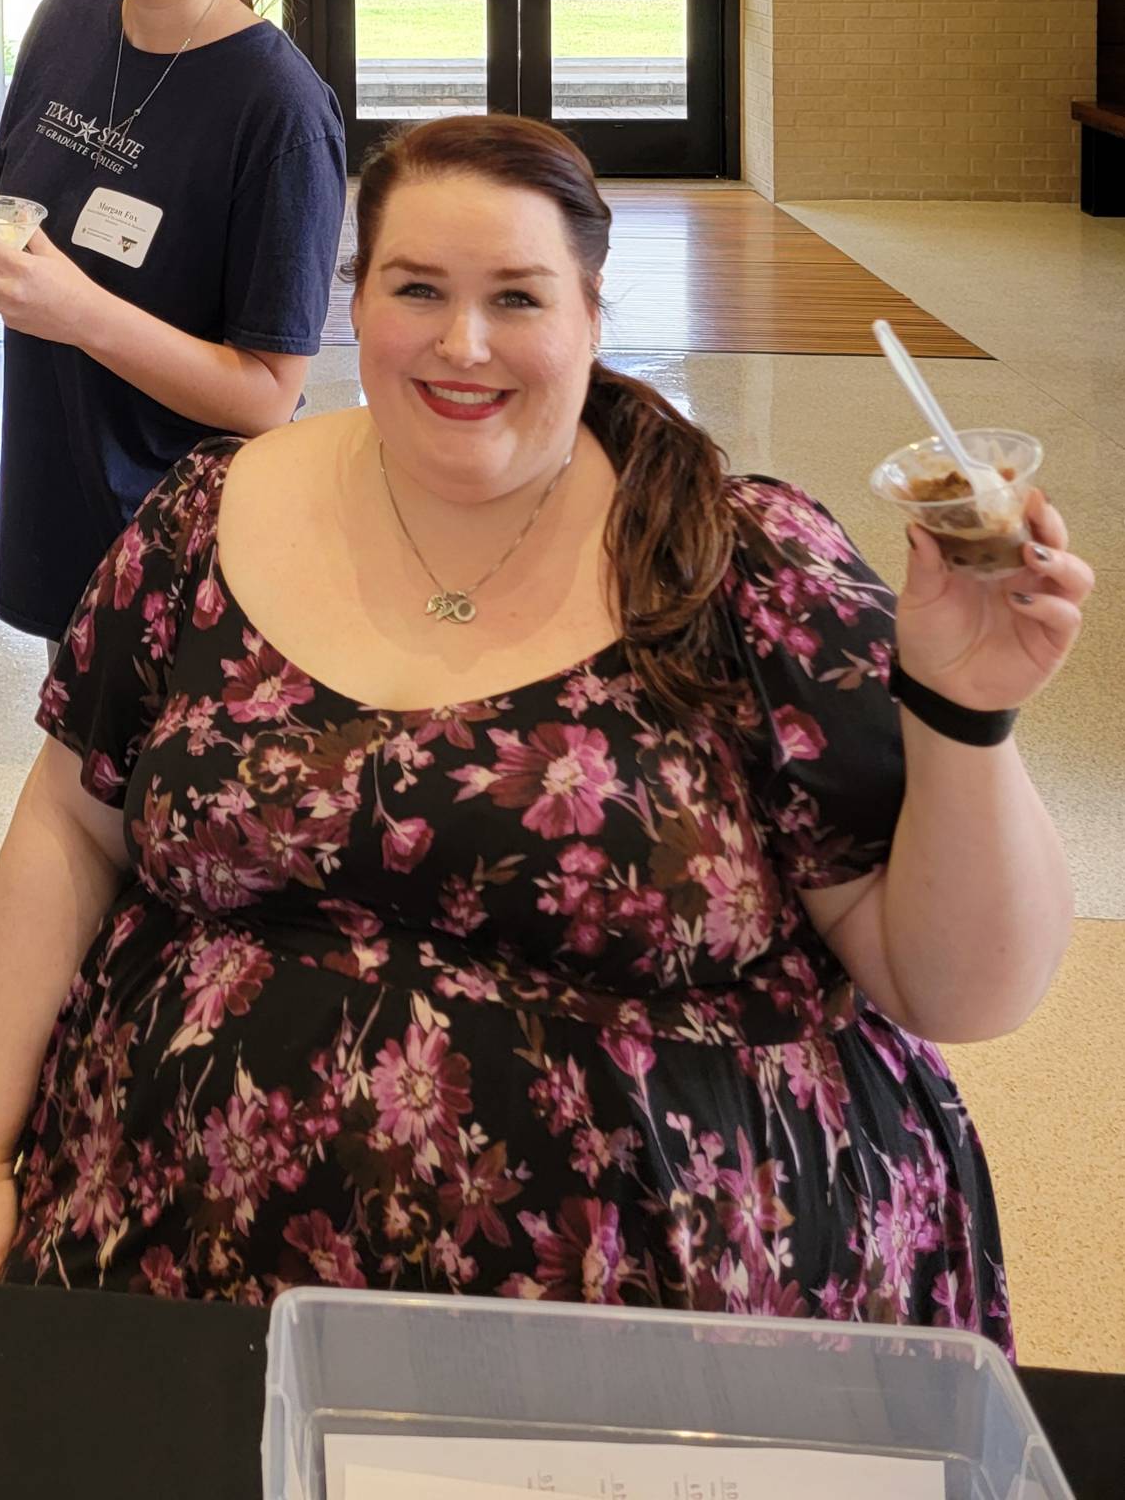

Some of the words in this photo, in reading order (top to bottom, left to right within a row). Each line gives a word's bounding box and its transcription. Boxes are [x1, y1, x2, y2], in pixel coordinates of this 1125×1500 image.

[45, 100, 83, 128] TEXAS
[97, 127, 145, 160] STATE
[45, 128, 90, 156] GRADUATE
